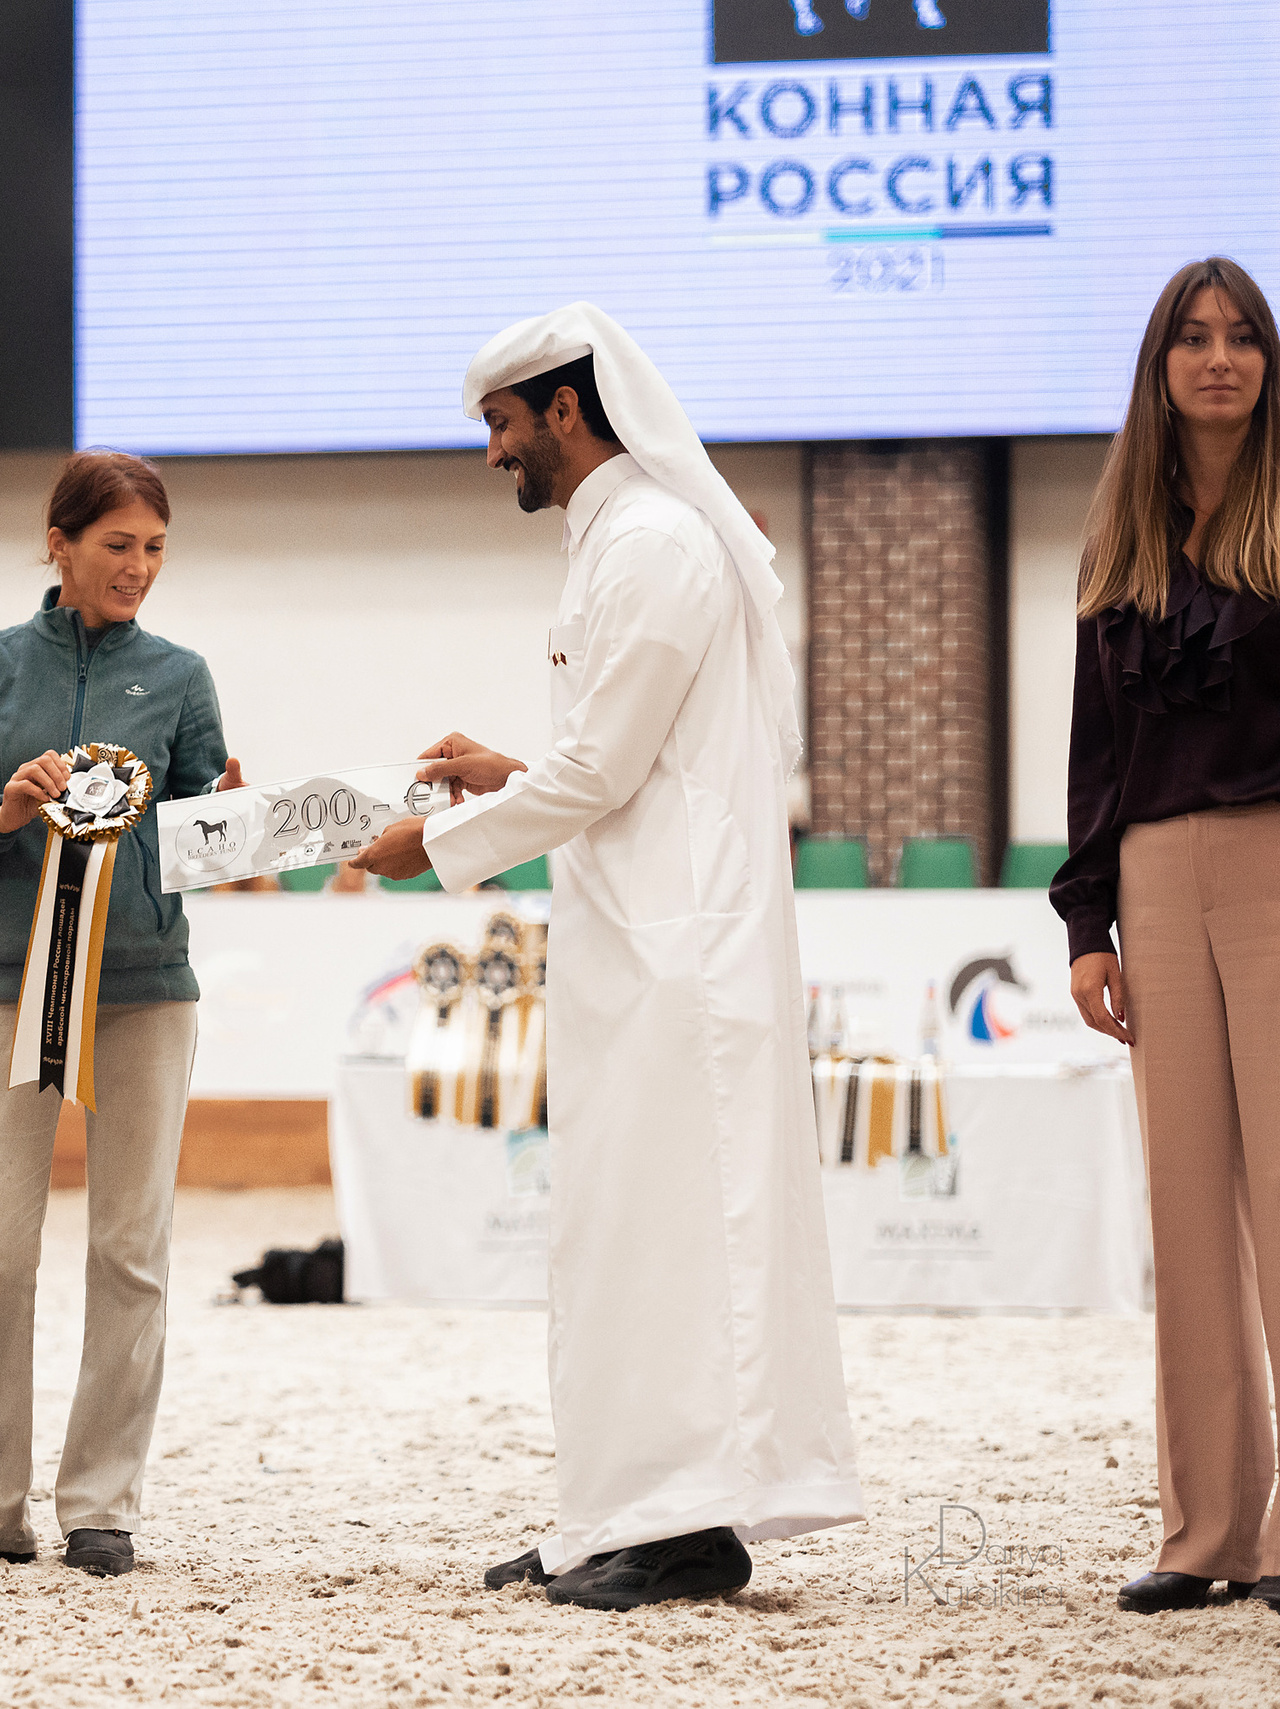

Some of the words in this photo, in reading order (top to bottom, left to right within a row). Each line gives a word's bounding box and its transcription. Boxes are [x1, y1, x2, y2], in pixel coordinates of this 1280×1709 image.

[706, 72, 1055, 139] КОННАЯ
[706, 151, 1055, 217] РОССИЯ
[825, 246, 946, 292] 2021
[58, 898, 66, 937] лошадей
[67, 907, 75, 941] породы
[53, 938, 62, 968] России
[60, 943, 72, 1004] чистокровной
[48, 970, 59, 1018] Чемпионат
[46, 1020, 54, 1044] XVIII
[57, 1006, 65, 1046] арабской
